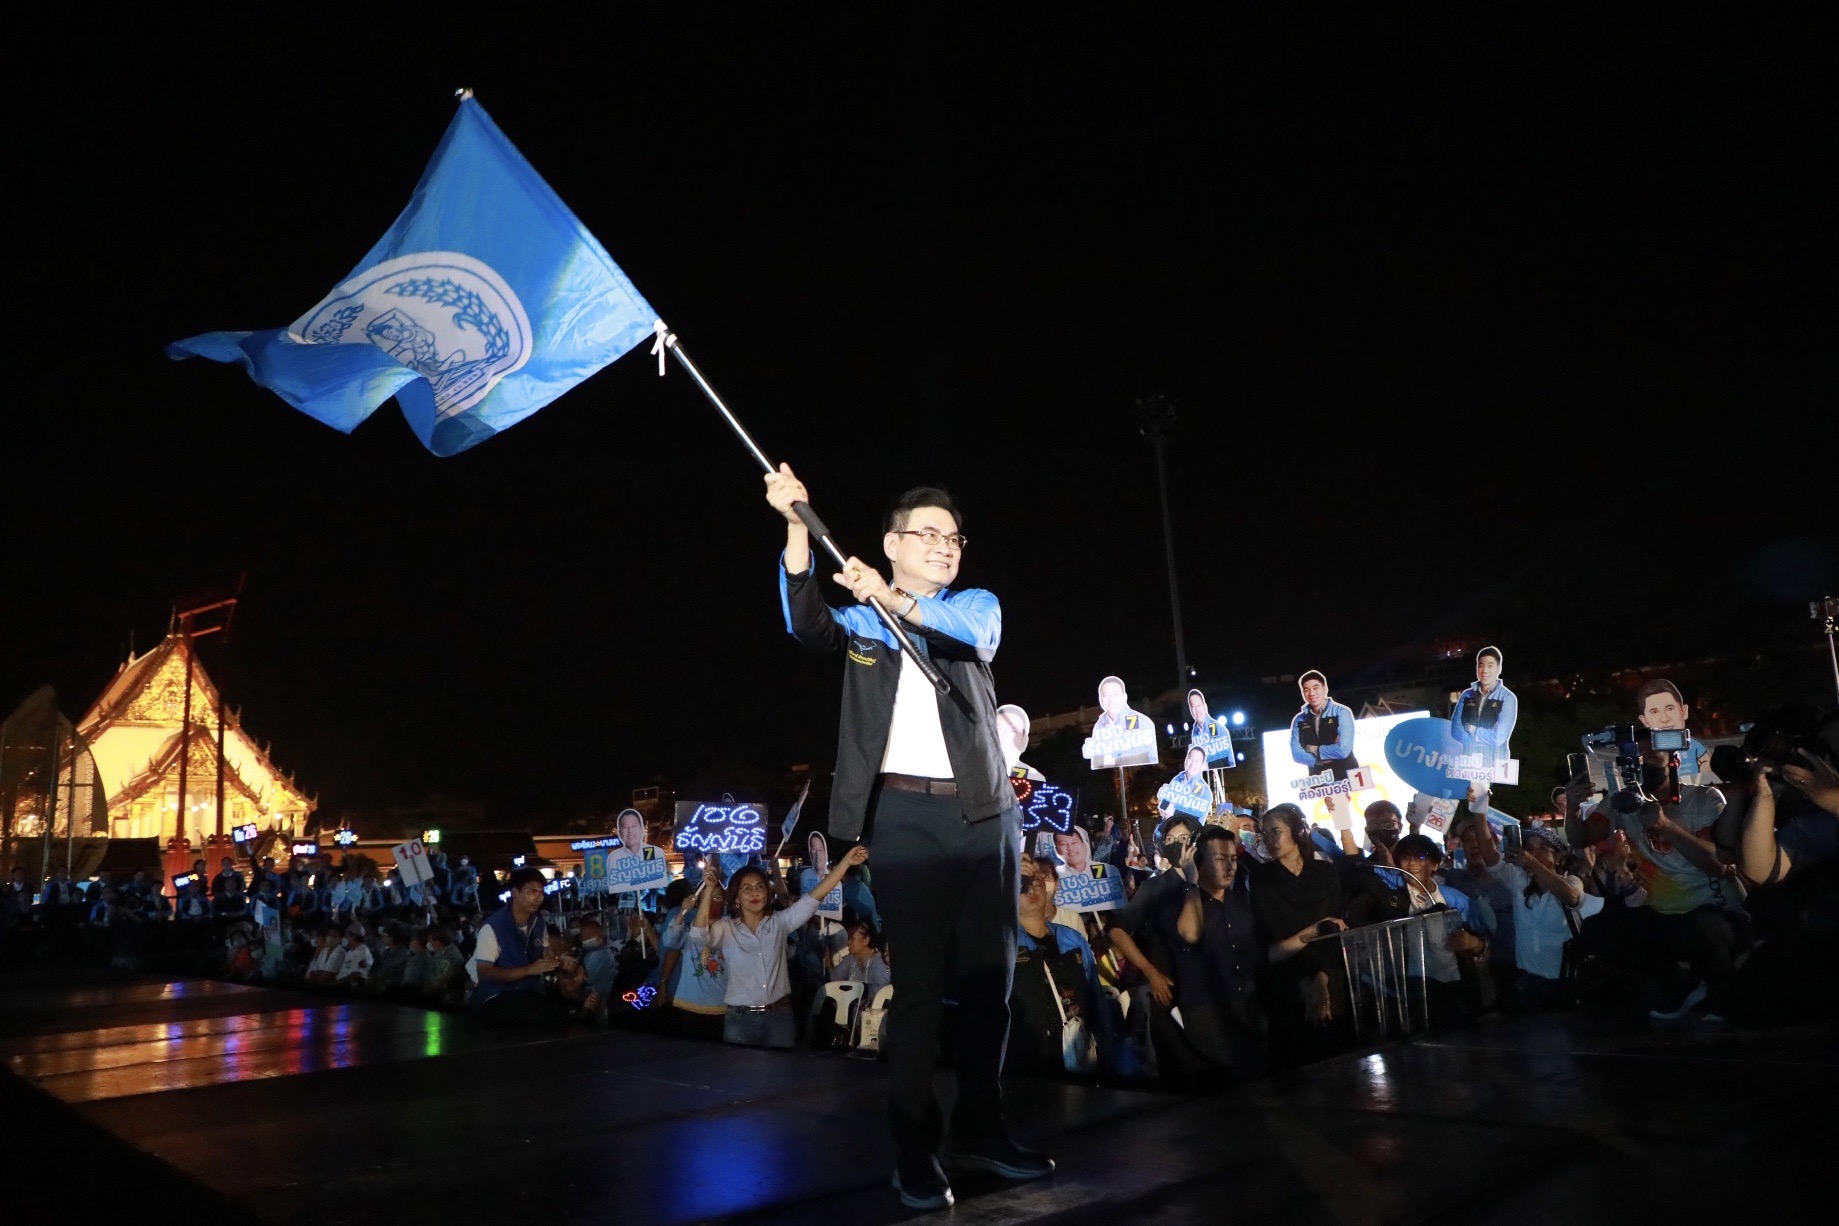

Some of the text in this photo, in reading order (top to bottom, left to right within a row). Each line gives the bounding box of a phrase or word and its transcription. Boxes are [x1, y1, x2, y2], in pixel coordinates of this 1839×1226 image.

[1126, 715, 1137, 730] 7
[1208, 723, 1217, 736] 7
[1012, 767, 1027, 778] 7
[1500, 762, 1509, 779] 1
[1290, 769, 1334, 789] บางกะปิ
[1354, 771, 1365, 787] 1
[1193, 782, 1204, 794] 7
[1299, 780, 1349, 801] ต้องเบอร์
[1428, 814, 1444, 828] 26
[643, 847, 654, 860] 7
[589, 854, 605, 879] 8
[616, 855, 640, 871] เชง
[1091, 865, 1104, 879] 7
[560, 879, 571, 889] FC
[1060, 874, 1090, 890] เชง
